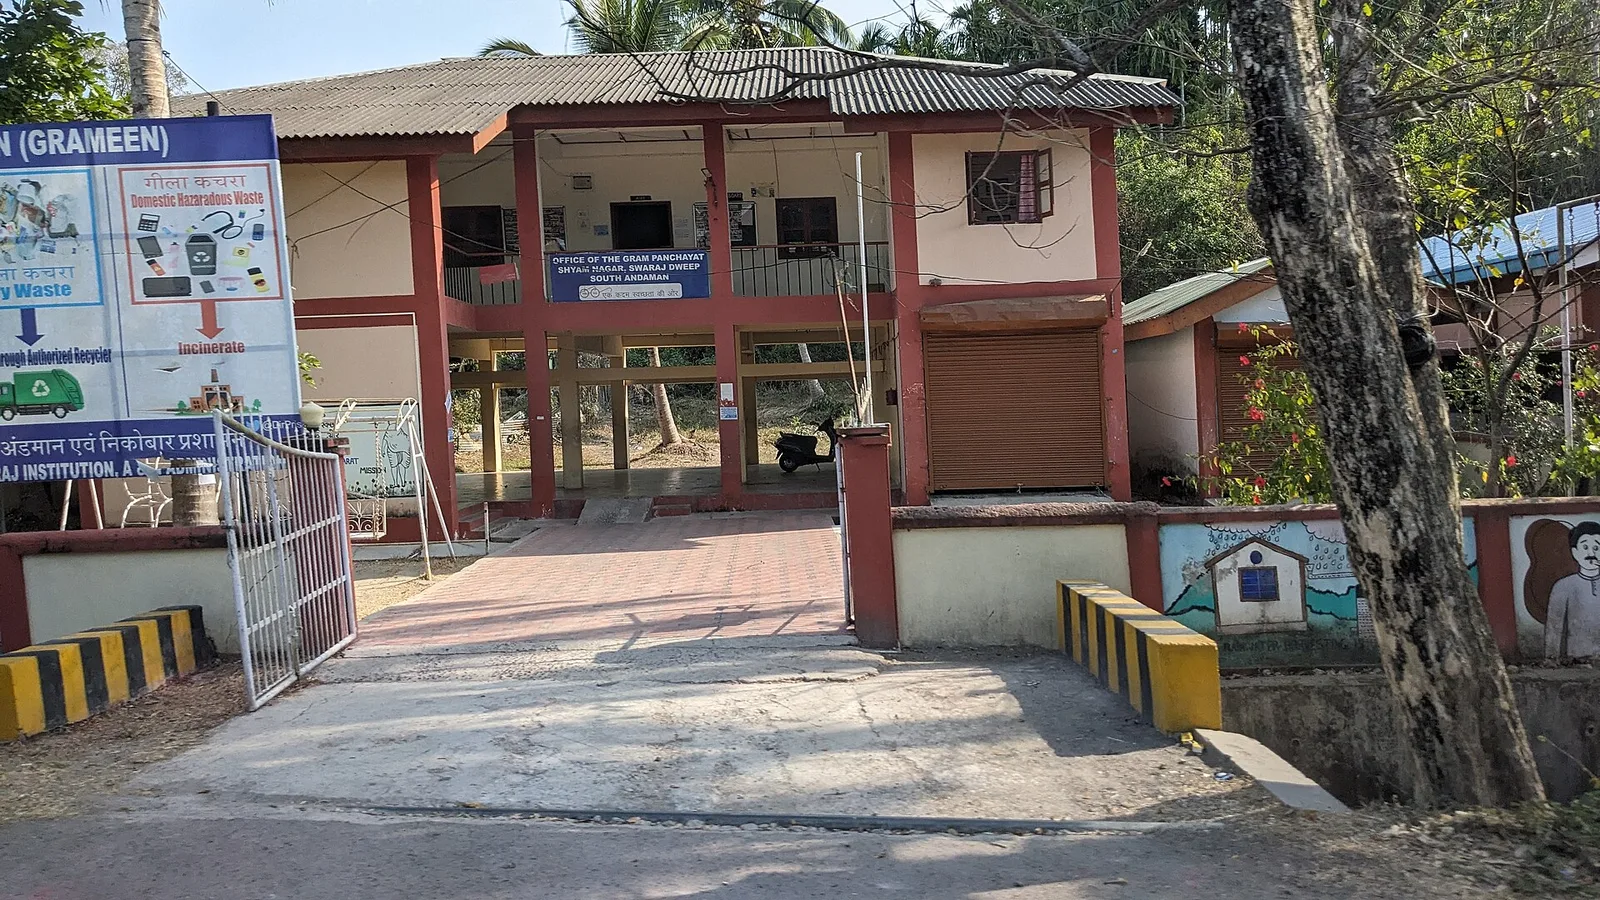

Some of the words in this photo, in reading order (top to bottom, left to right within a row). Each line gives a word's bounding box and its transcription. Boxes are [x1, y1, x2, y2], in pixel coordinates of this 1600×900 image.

[19, 125, 169, 163] (GRAMEEN)
[144, 172, 189, 190] गीला
[193, 175, 247, 189] कचरा
[131, 193, 176, 208] Domestic
[178, 191, 232, 207] Hazaradous
[233, 190, 264, 205] Waste
[552, 256, 585, 265] OFFICE
[587, 256, 600, 264] OF
[602, 255, 620, 263] THE
[622, 254, 649, 263] GRAM
[651, 253, 705, 262] PANCHAYAT
[22, 266, 76, 280] कचरा
[557, 265, 590, 274] SHYAM
[628, 264, 666, 272] SWARAJ
[669, 263, 701, 271] DWEEP
[590, 274, 622, 283] SOUTH
[624, 273, 670, 282] ANDAMAN
[14, 283, 72, 298] Waste
[27, 347, 73, 366] Authorized
[74, 346, 112, 365] Recycler
[178, 341, 245, 355] Incinerate
[0, 436, 66, 457] अंडमान
[68, 432, 97, 456] एवं
[99, 428, 176, 453] निकोबार
[0, 464, 19, 482] AJ
[122, 460, 133, 476] A
